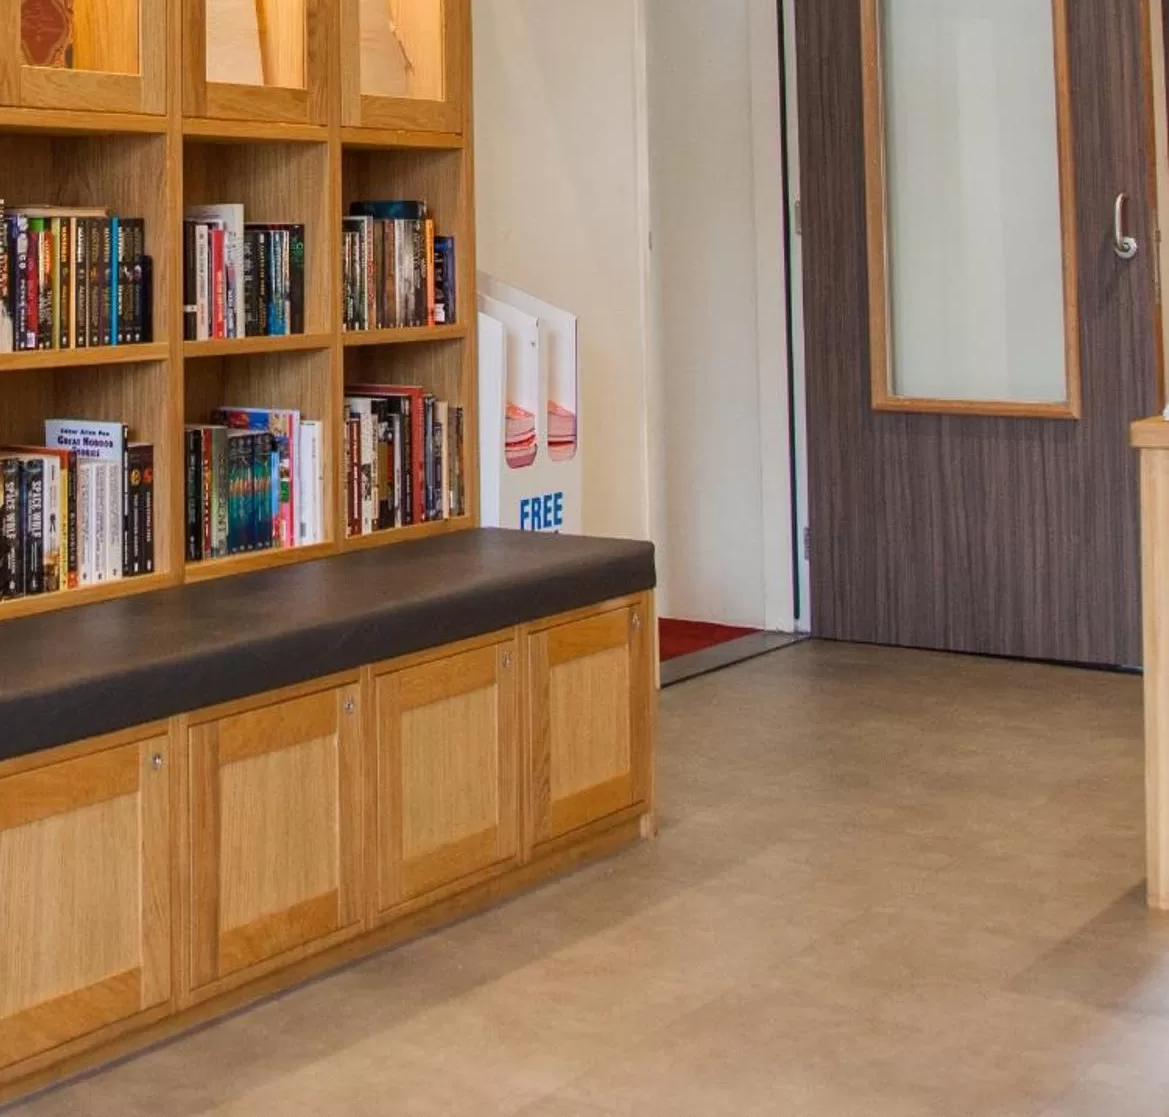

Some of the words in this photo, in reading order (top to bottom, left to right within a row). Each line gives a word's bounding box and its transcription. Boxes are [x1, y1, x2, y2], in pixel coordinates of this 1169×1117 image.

[6, 482, 16, 510] SPACE
[32, 480, 42, 508] SPACE
[32, 511, 42, 538] WOLF
[520, 491, 563, 531] FREE
[6, 512, 17, 539] WOLF
